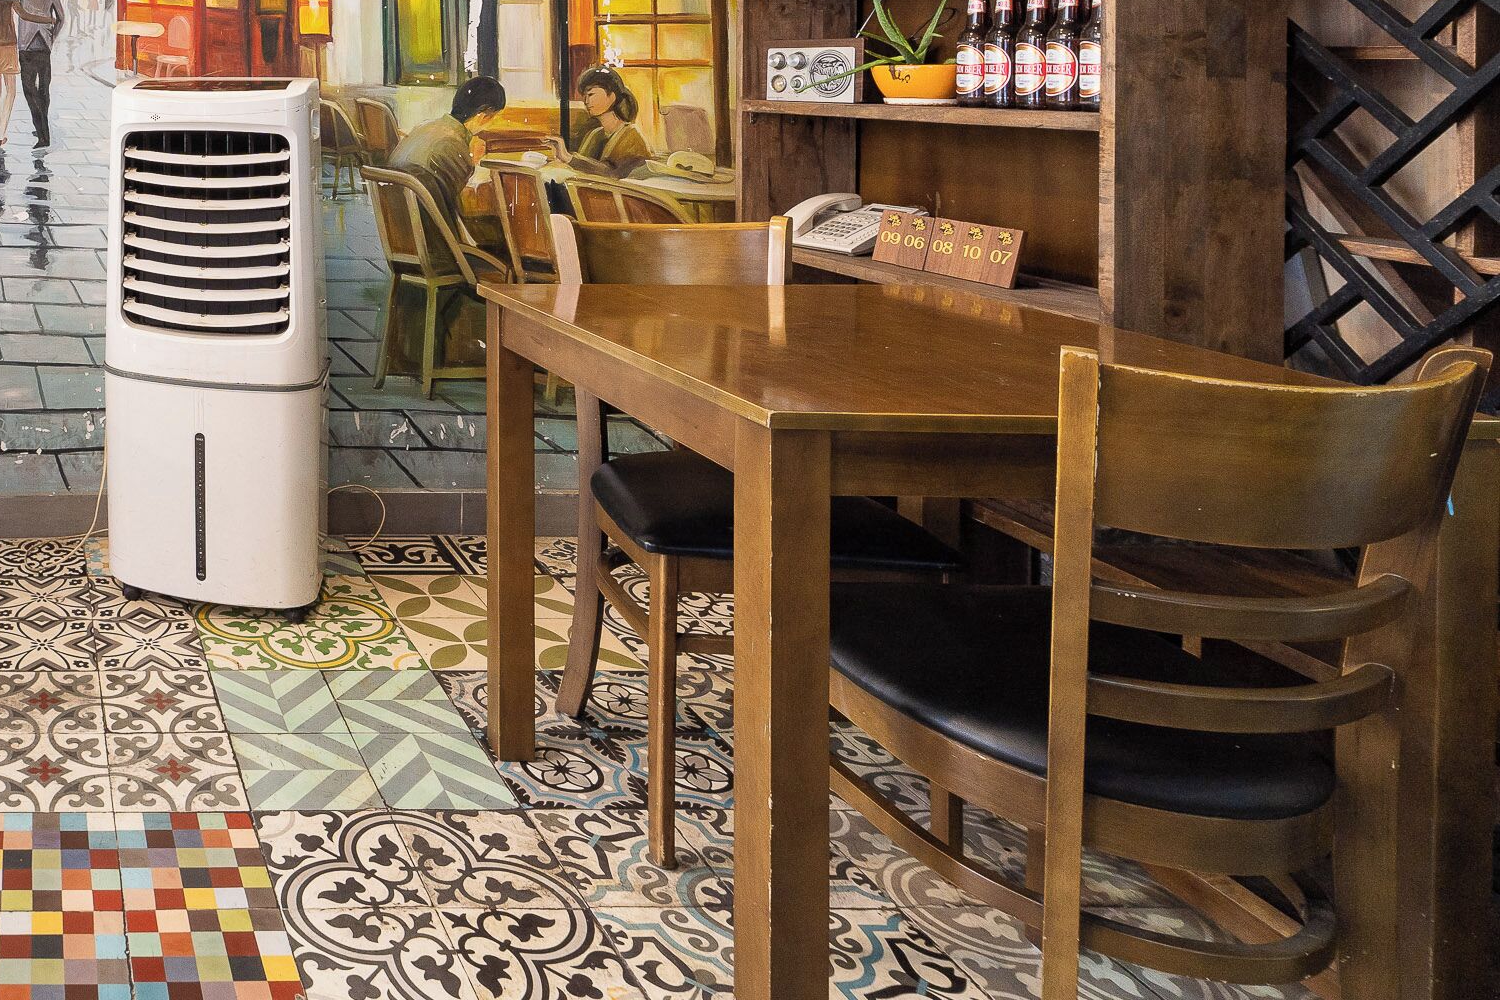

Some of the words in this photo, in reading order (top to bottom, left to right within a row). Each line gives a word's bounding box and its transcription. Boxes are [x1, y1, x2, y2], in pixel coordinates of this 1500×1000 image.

[964, 64, 982, 75] BEER
[989, 64, 1006, 75] BEER
[1023, 64, 1043, 76] BEER
[1052, 64, 1072, 76] BEER
[880, 230, 901, 245] 09
[904, 234, 925, 250] 06
[932, 239, 954, 255] 08
[963, 244, 981, 260] 10
[989, 249, 1013, 265] 07
